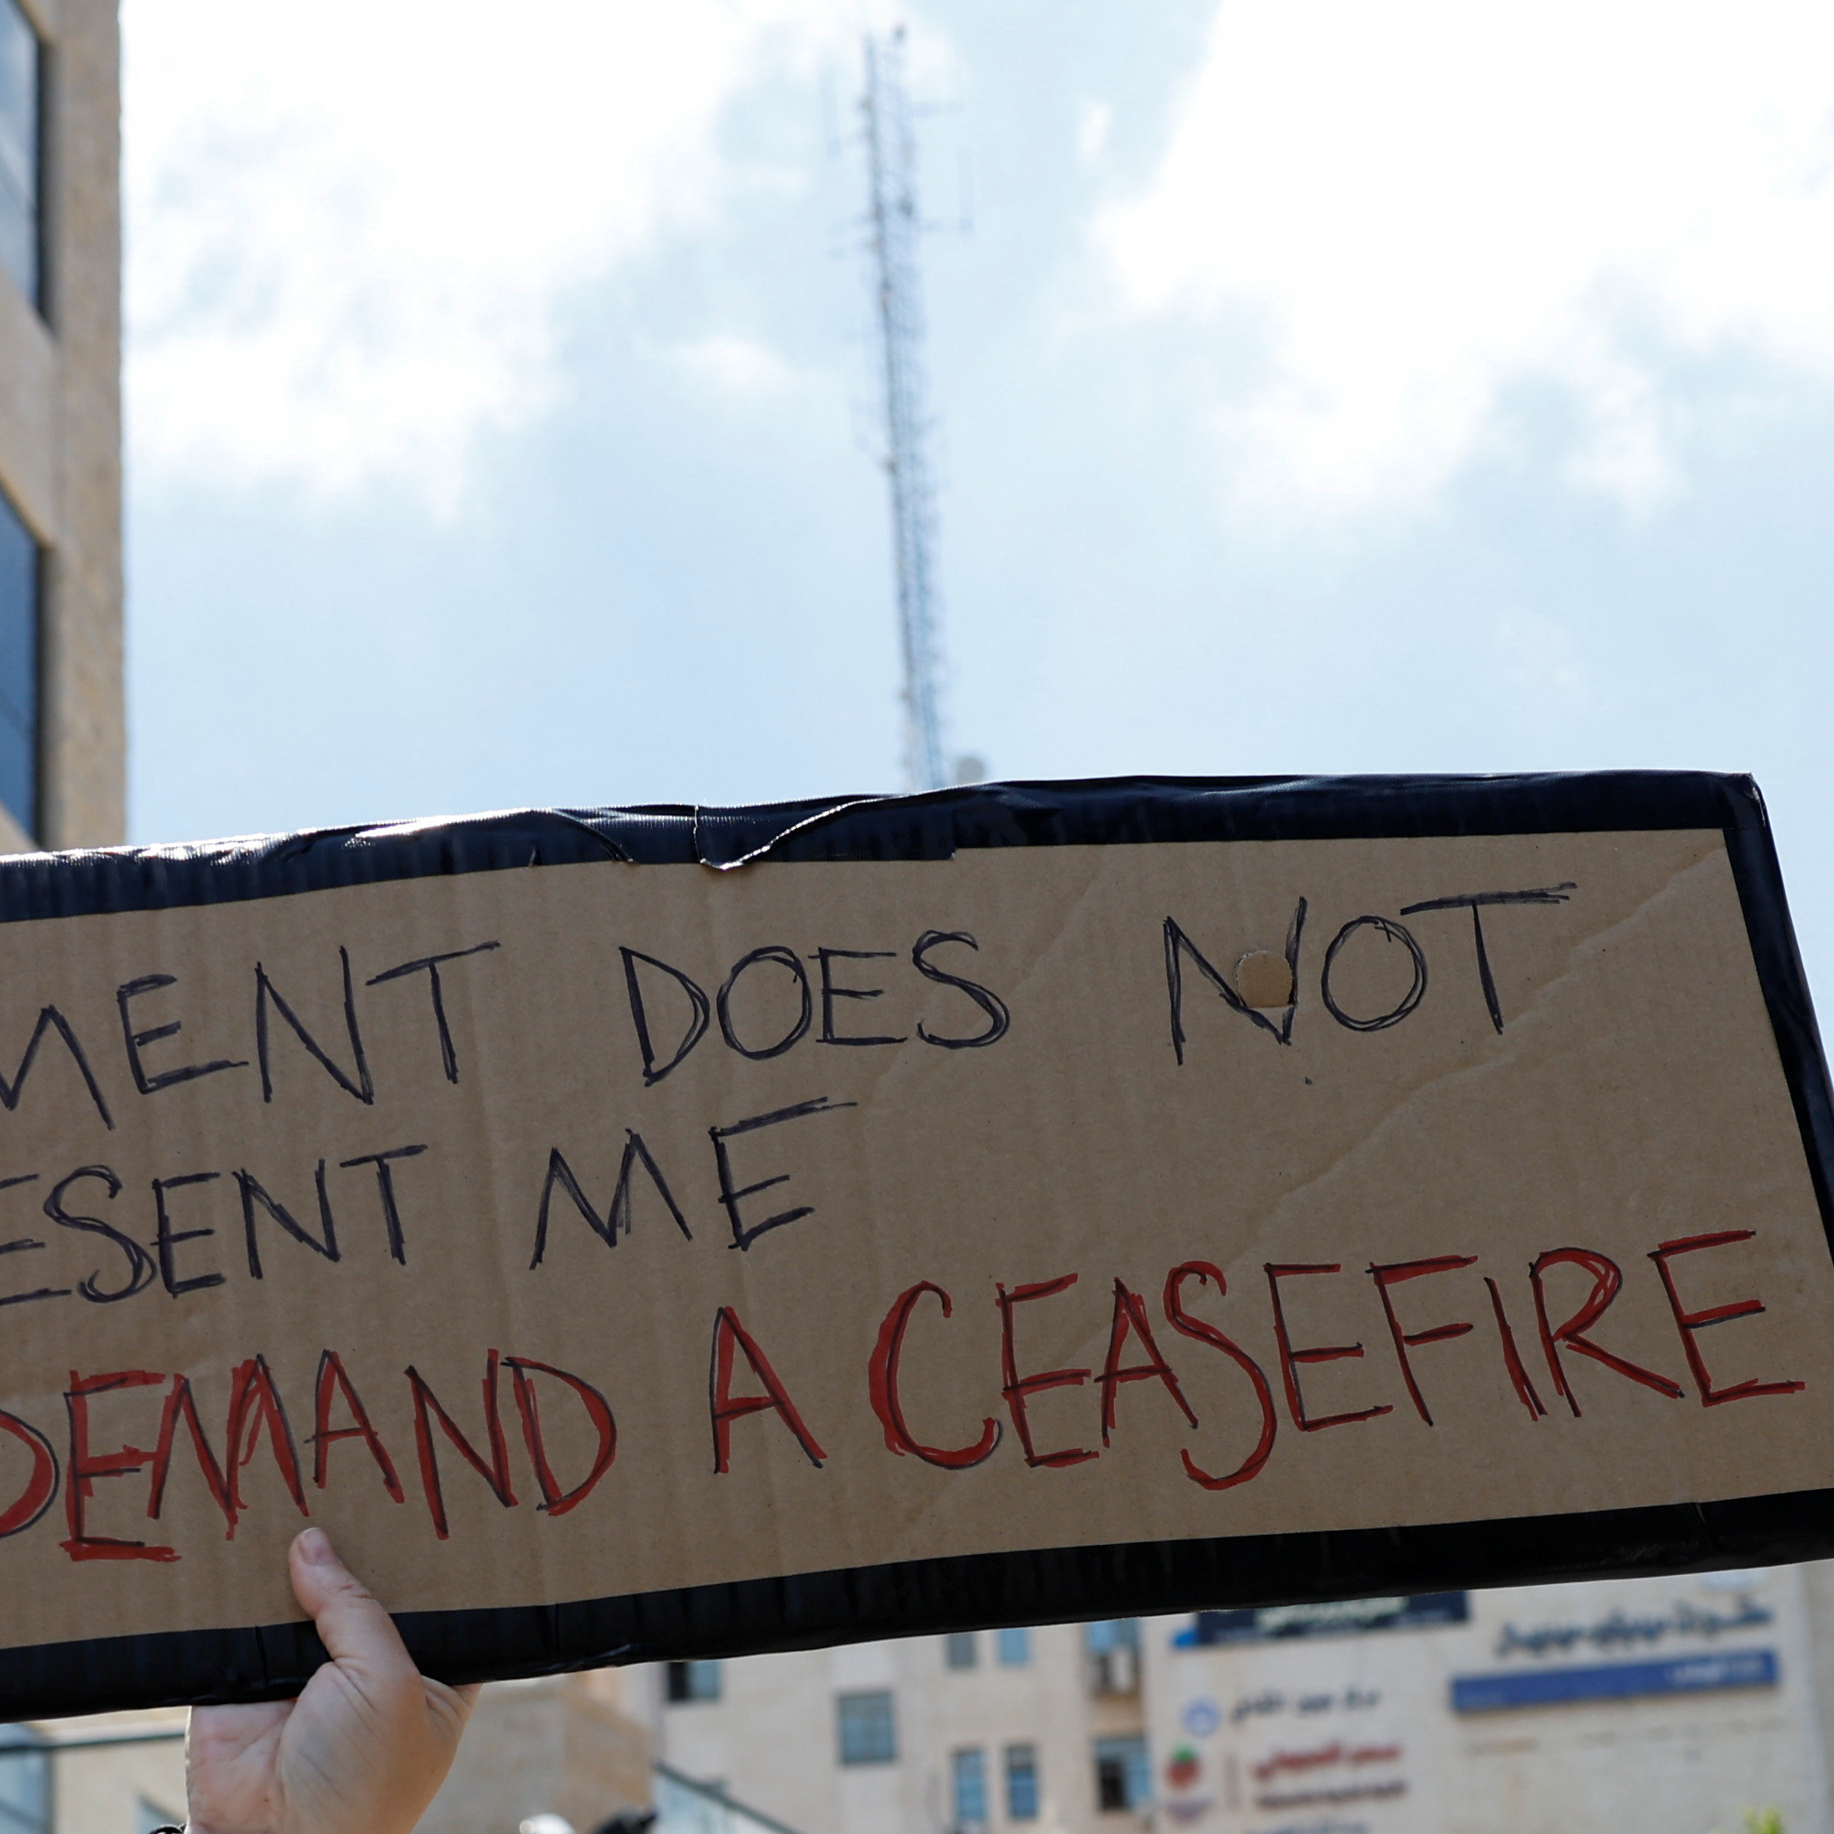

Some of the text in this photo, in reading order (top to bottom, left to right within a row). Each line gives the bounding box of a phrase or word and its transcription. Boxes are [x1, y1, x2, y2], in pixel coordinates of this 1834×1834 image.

[618, 929, 1011, 1086] DOES
[1165, 880, 1579, 1066] NOT
[530, 1099, 857, 1272] ME
[709, 1304, 827, 1477] A
[868, 1227, 1807, 1492] CEASEFIRE
